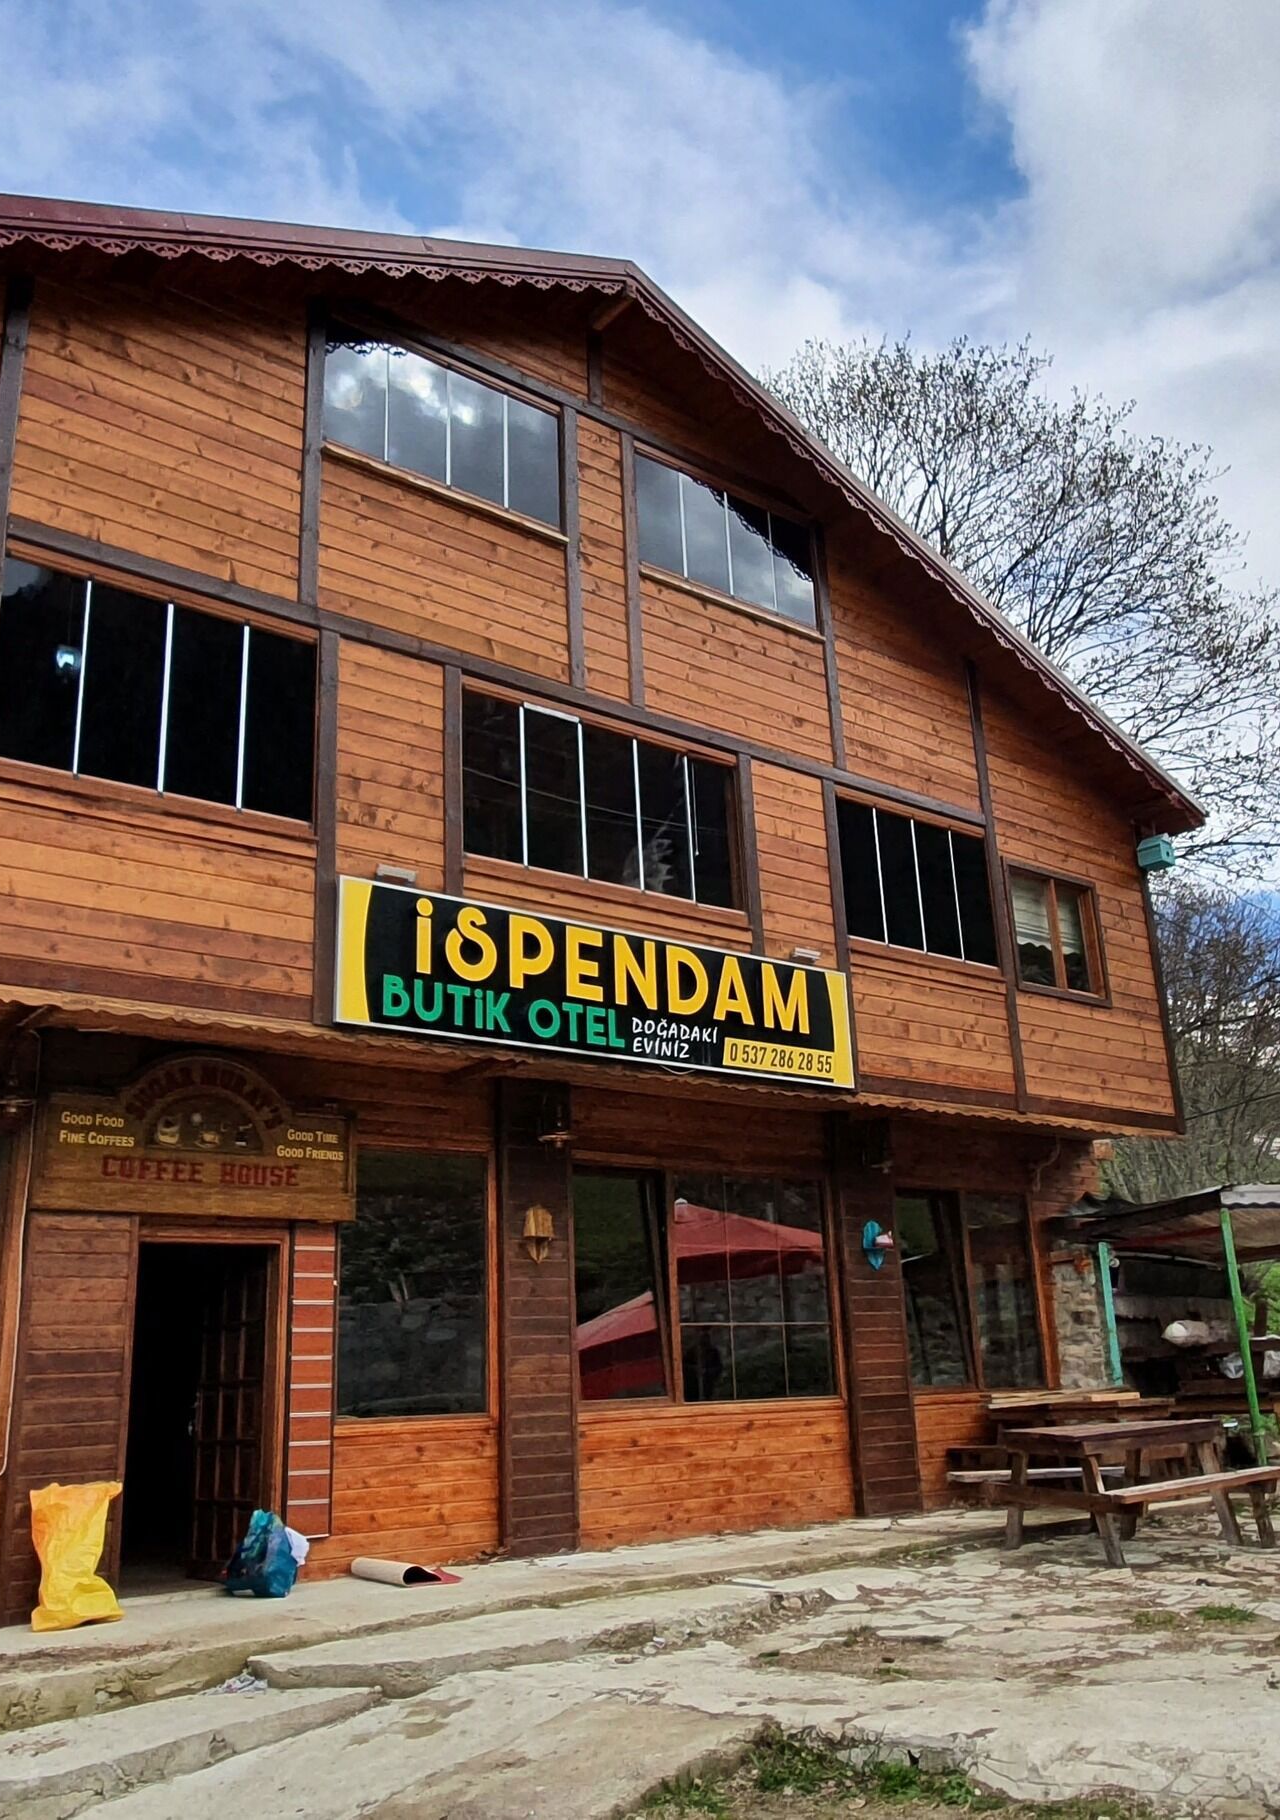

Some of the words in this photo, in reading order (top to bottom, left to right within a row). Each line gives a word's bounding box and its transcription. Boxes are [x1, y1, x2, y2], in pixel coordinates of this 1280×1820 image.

[528, 998, 625, 1048] OTEL
[729, 1043, 738, 1062] 0
[741, 1045, 767, 1066] 537
[771, 1048, 794, 1069] 286
[798, 1052, 813, 1071] 28
[816, 1055, 832, 1074] 55
[101, 1154, 204, 1183] COFFEE
[220, 1163, 300, 1187] HOUSE
